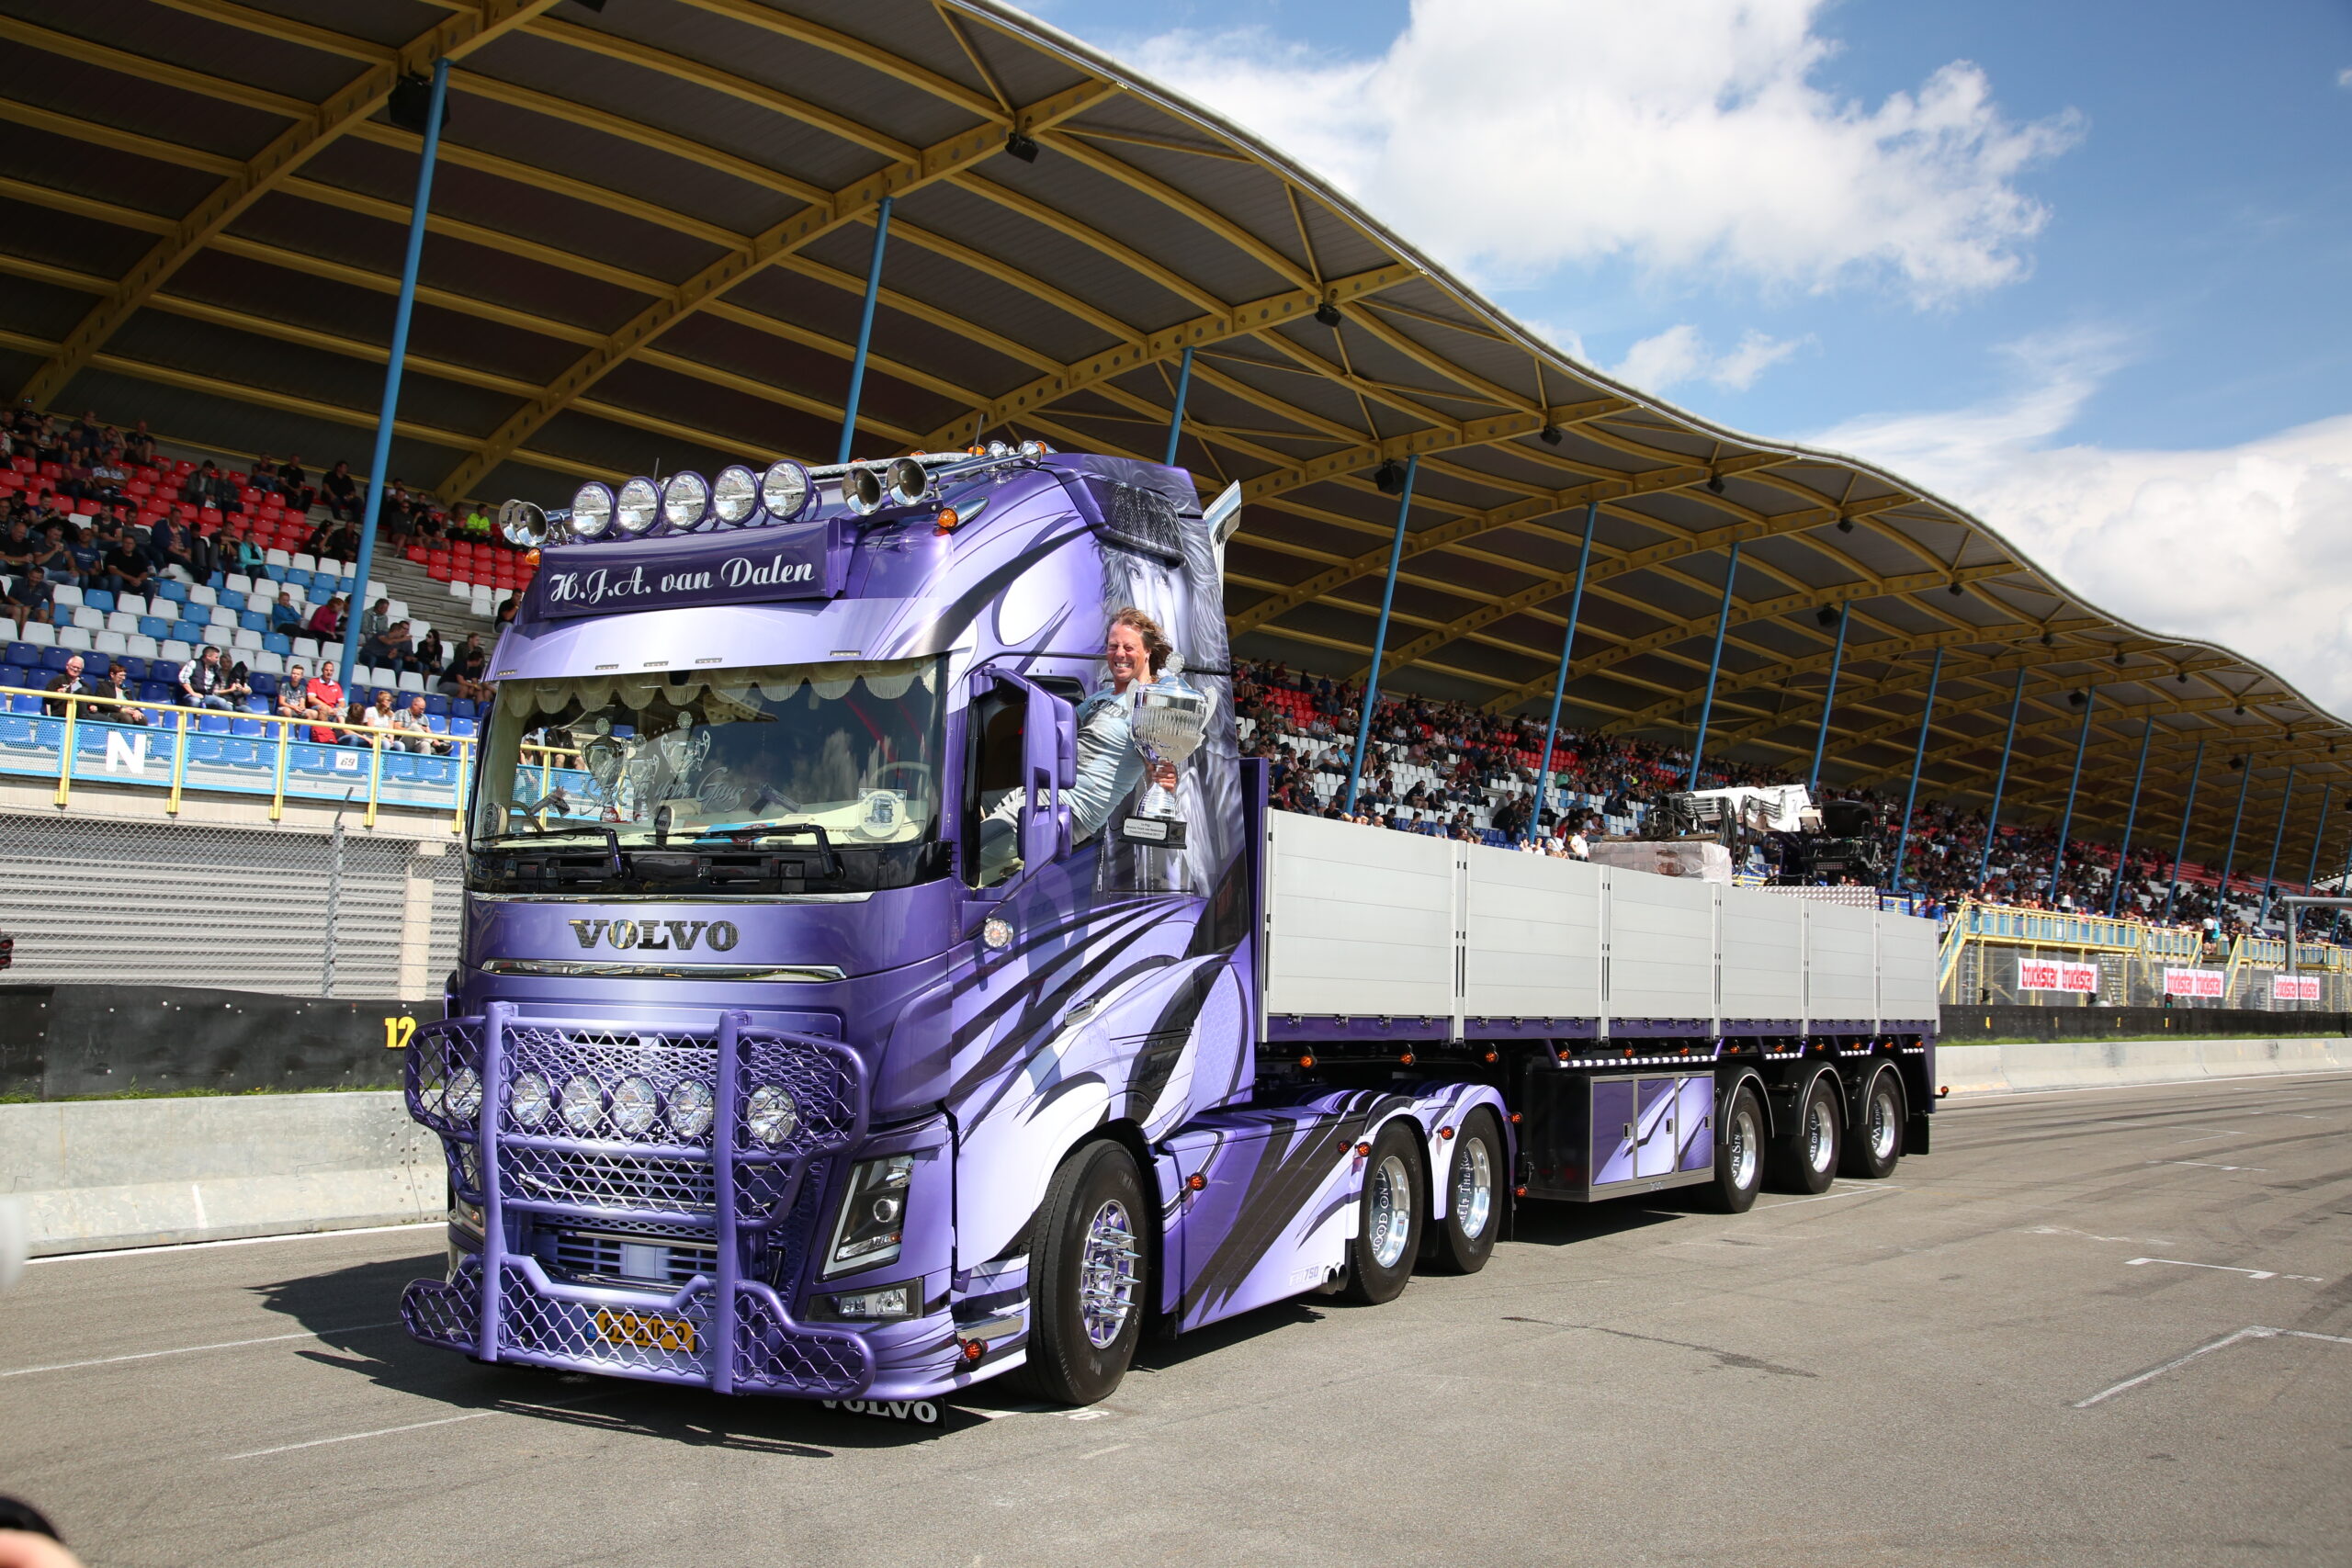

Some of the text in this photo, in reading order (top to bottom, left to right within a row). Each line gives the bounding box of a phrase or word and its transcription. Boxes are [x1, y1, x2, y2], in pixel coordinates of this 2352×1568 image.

[549, 554, 815, 604] H.J.A. van Dalen
[106, 730, 147, 774] N
[568, 919, 741, 953] VOLVO
[384, 1016, 417, 1048] 12
[1379, 1187, 1390, 1210] ON
[1373, 1212, 1389, 1256] LOOD
[1304, 1266, 1319, 1280] 750
